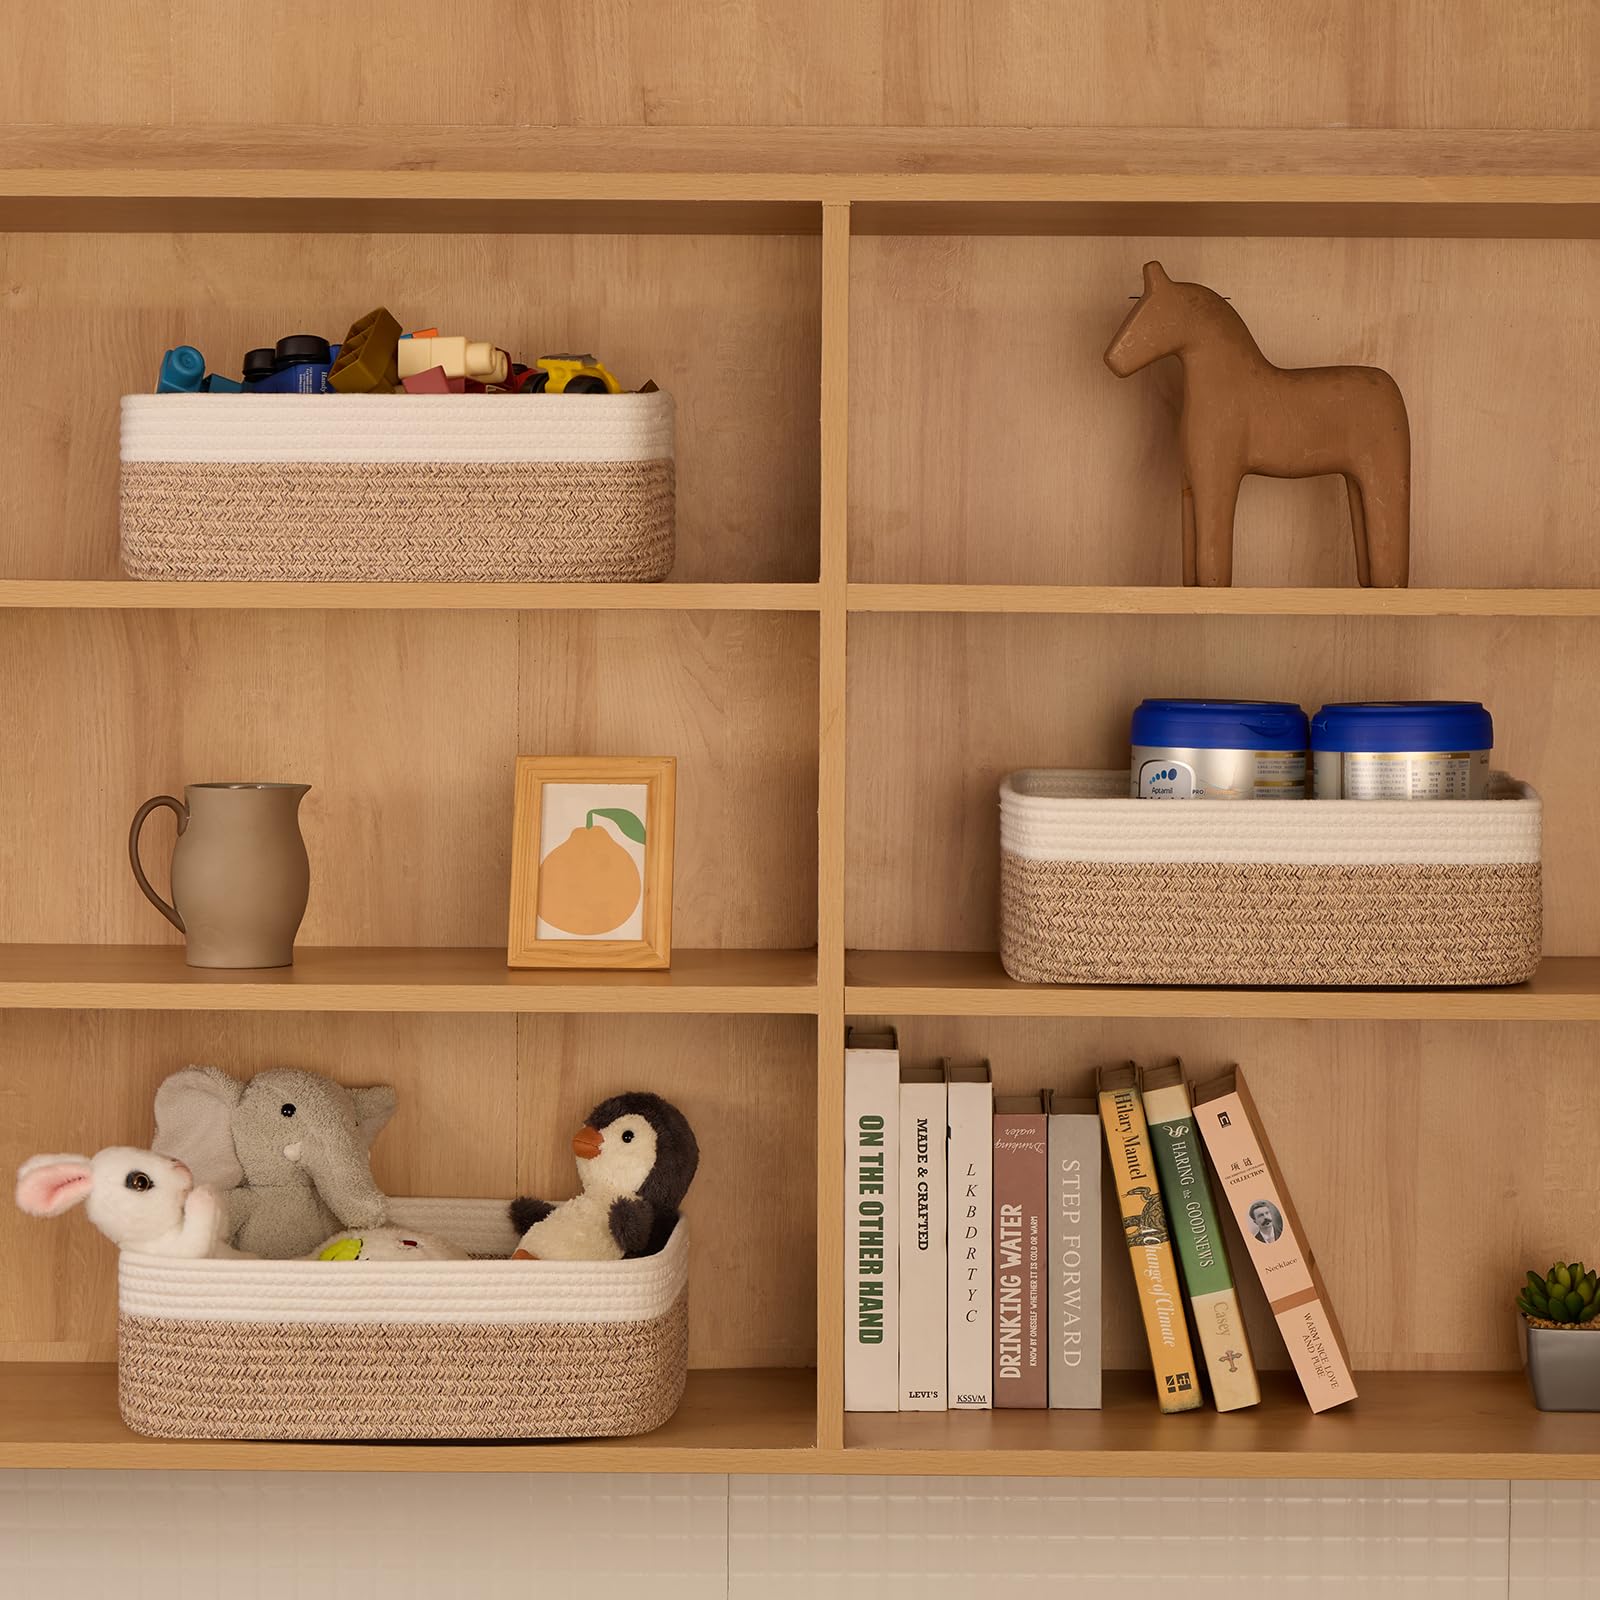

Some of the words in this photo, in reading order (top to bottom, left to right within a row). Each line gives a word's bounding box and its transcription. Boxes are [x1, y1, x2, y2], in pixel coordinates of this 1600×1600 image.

[1114, 1093, 1134, 1132] Hilary
[858, 1115, 884, 1146] ON
[917, 1118, 928, 1163] MADE
[994, 1138, 1046, 1154] Drinking
[1003, 1128, 1036, 1139] water
[858, 1152, 884, 1195] THE
[917, 1167, 929, 1178] &
[1122, 1135, 1147, 1180] Mantel
[1062, 1159, 1081, 1224] STEP
[1229, 1169, 1265, 1185] COLLECTION
[917, 1181, 929, 1251] CRAFTED
[1030, 1216, 1038, 1235] WARM
[1186, 1201, 1206, 1234] GOOD
[858, 1201, 884, 1275] OTHER
[1000, 1203, 1023, 1269] WATER
[1030, 1236, 1038, 1245] OR
[1194, 1234, 1215, 1268] NEWS
[1030, 1246, 1038, 1261] COLD
[1030, 1262, 1038, 1270] IS
[1143, 1236, 1162, 1282] Change
[1265, 1258, 1297, 1274] Necklace
[1030, 1280, 1038, 1309] WHETHER
[1062, 1234, 1082, 1368] FORWARD
[1147, 1283, 1171, 1298] of
[858, 1281, 884, 1344] HAND
[1000, 1275, 1022, 1379] DRINKING
[1030, 1310, 1038, 1337] ONESELF
[1155, 1298, 1176, 1348] Climate
[1213, 1301, 1231, 1337] Casey
[1030, 1338, 1038, 1346] BY
[1030, 1347, 1038, 1367] KNOW
[1302, 1334, 1316, 1354] AND
[1311, 1355, 1326, 1378] PURE
[1303, 1312, 1320, 1342] WARM
[1315, 1342, 1329, 1365] NICE
[1324, 1365, 1340, 1390] LOVE
[909, 1391, 938, 1399] LEVI'S
[956, 1394, 987, 1403] KSSVM
